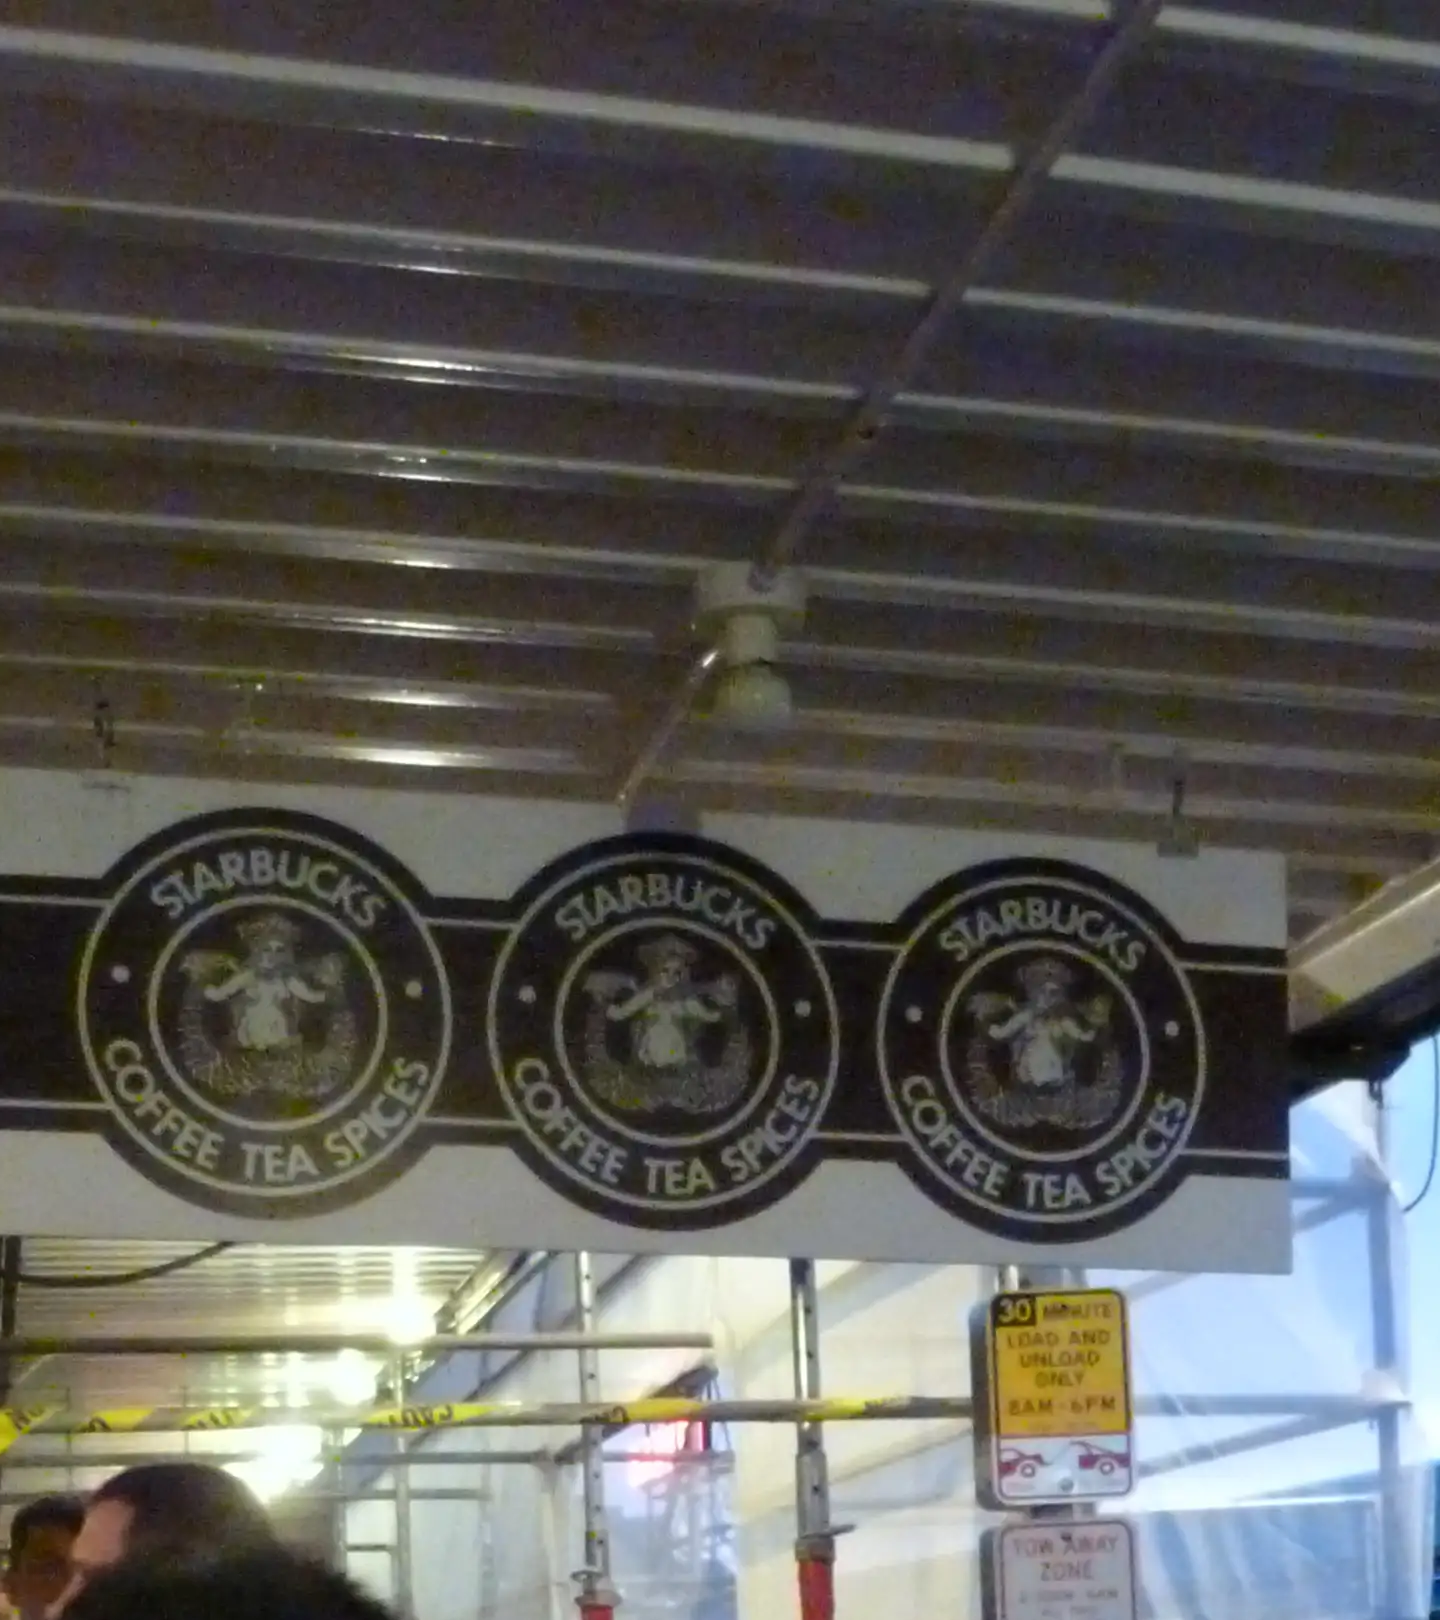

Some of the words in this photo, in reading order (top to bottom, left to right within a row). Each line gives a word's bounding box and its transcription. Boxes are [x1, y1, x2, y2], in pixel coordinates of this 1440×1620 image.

[150, 848, 386, 929] STARBUCKS
[555, 871, 778, 951] STARBUCKS
[938, 897, 1148, 973] STARBUCKS
[103, 1036, 225, 1172] COFFEE
[241, 1139, 320, 1185] TEA
[325, 1055, 429, 1169] SPICES
[514, 1056, 629, 1187] COFFEE
[642, 1158, 717, 1198] TEA
[722, 1072, 820, 1182] SPICES
[900, 1073, 1006, 1197] COFFEE
[1022, 1172, 1092, 1212] TEA
[1095, 1091, 1188, 1197] SPICES
[999, 1297, 1033, 1323] 30
[1006, 1332, 1060, 1350] LOAD
[1069, 1330, 1112, 1346] AND
[1020, 1351, 1101, 1369] UNLOAD
[1035, 1369, 1085, 1389] ONLY
